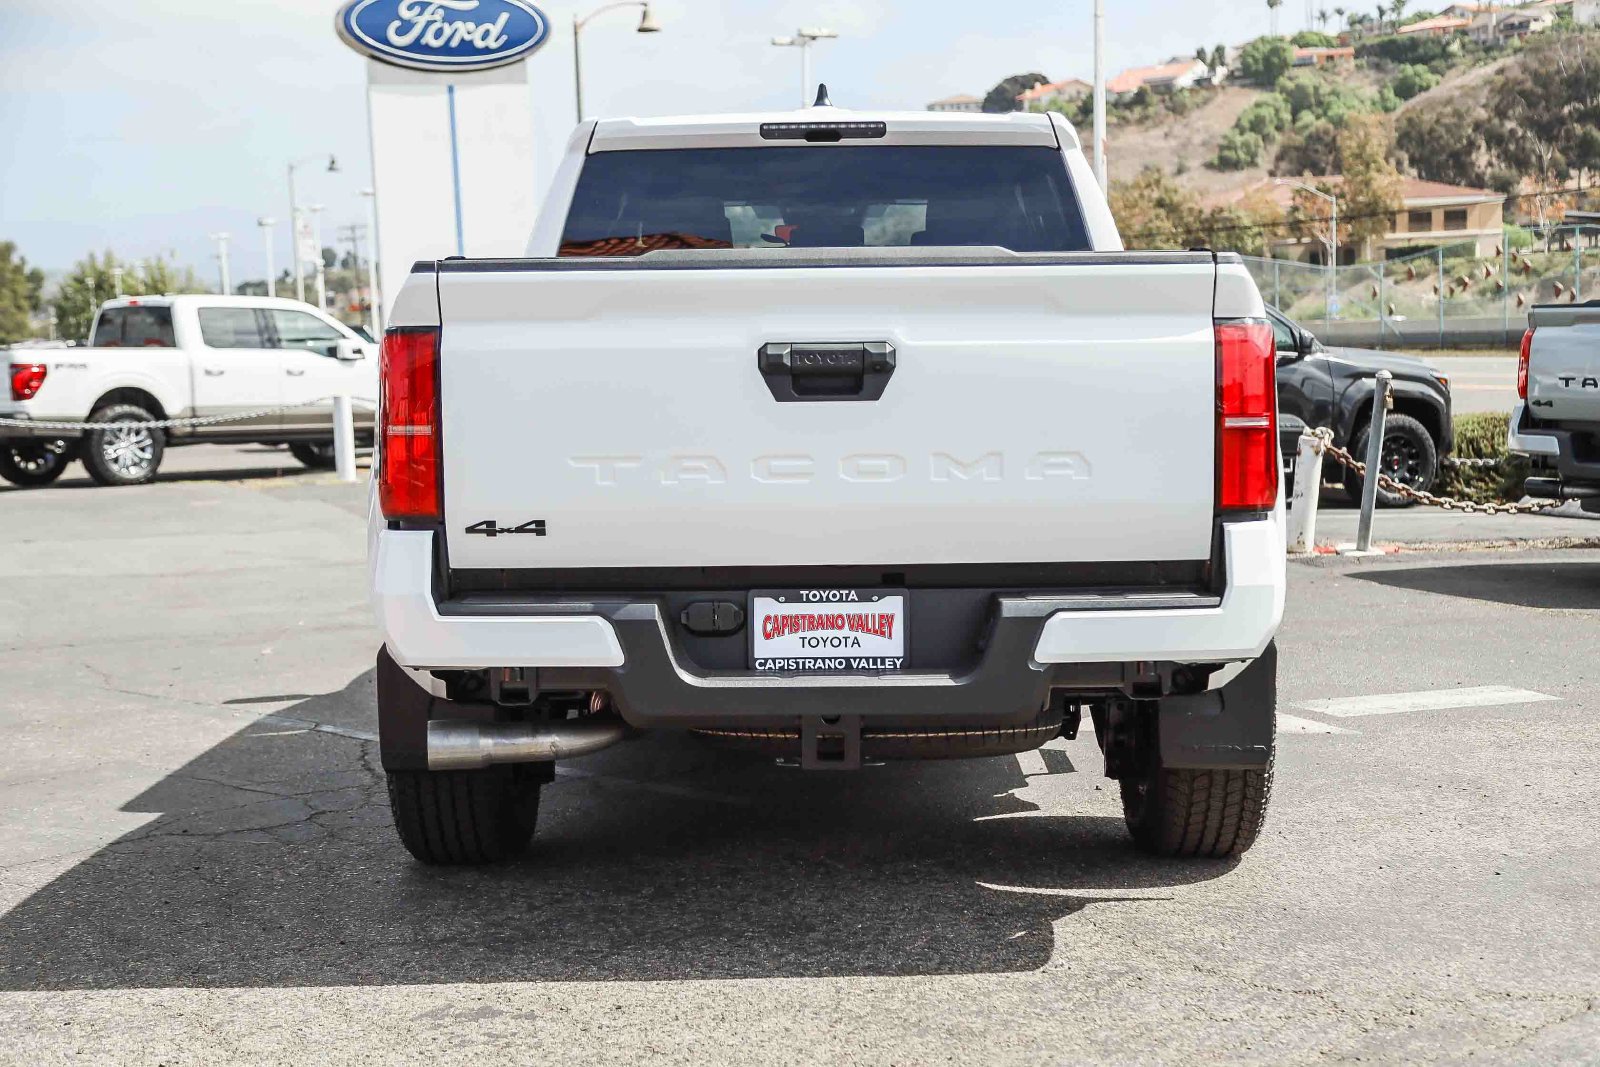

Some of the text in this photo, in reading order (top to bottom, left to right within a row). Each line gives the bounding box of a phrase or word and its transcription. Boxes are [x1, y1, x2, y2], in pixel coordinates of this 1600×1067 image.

[386, 0, 510, 49] Ford
[794, 354, 859, 365] TOYOTA
[567, 451, 1093, 485] TACOMA
[800, 590, 858, 602] TOYOTA
[762, 613, 895, 640] CAPISTRANO VALLEY
[799, 636, 861, 648] TOYOTA
[755, 658, 903, 670] CAPISTRANO VALLEY
